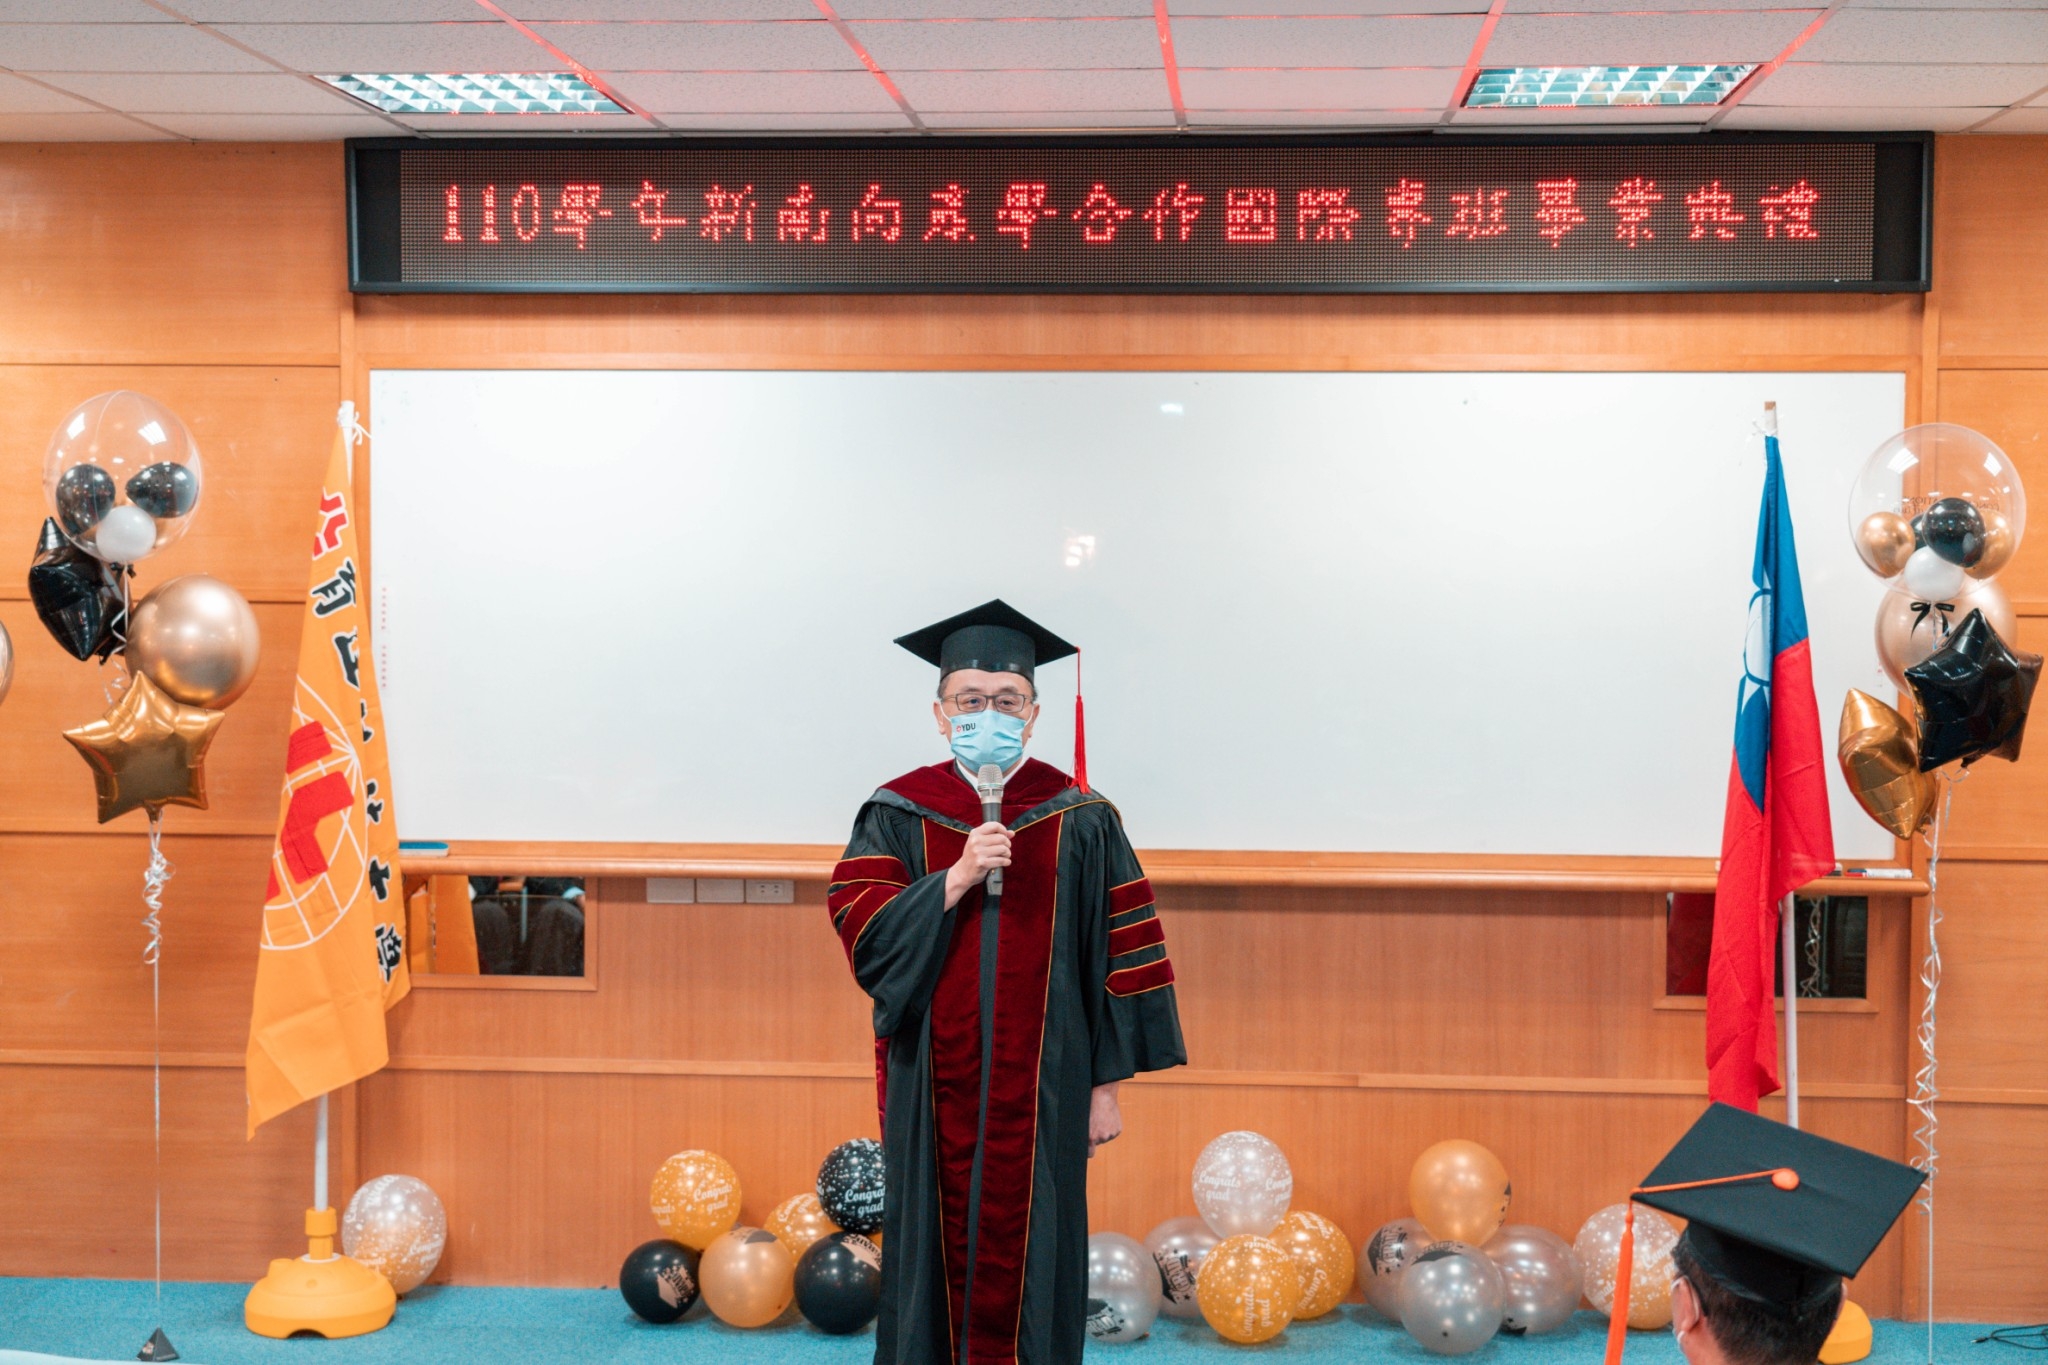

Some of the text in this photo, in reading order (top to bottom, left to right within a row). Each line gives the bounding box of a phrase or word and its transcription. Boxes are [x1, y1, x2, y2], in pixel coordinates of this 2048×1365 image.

[961, 723, 976, 732] YDU
[1200, 1169, 1241, 1189] Congrats
[1205, 1188, 1230, 1203] grad
[858, 1197, 885, 1218] grad
[1256, 1299, 1275, 1328] grad
